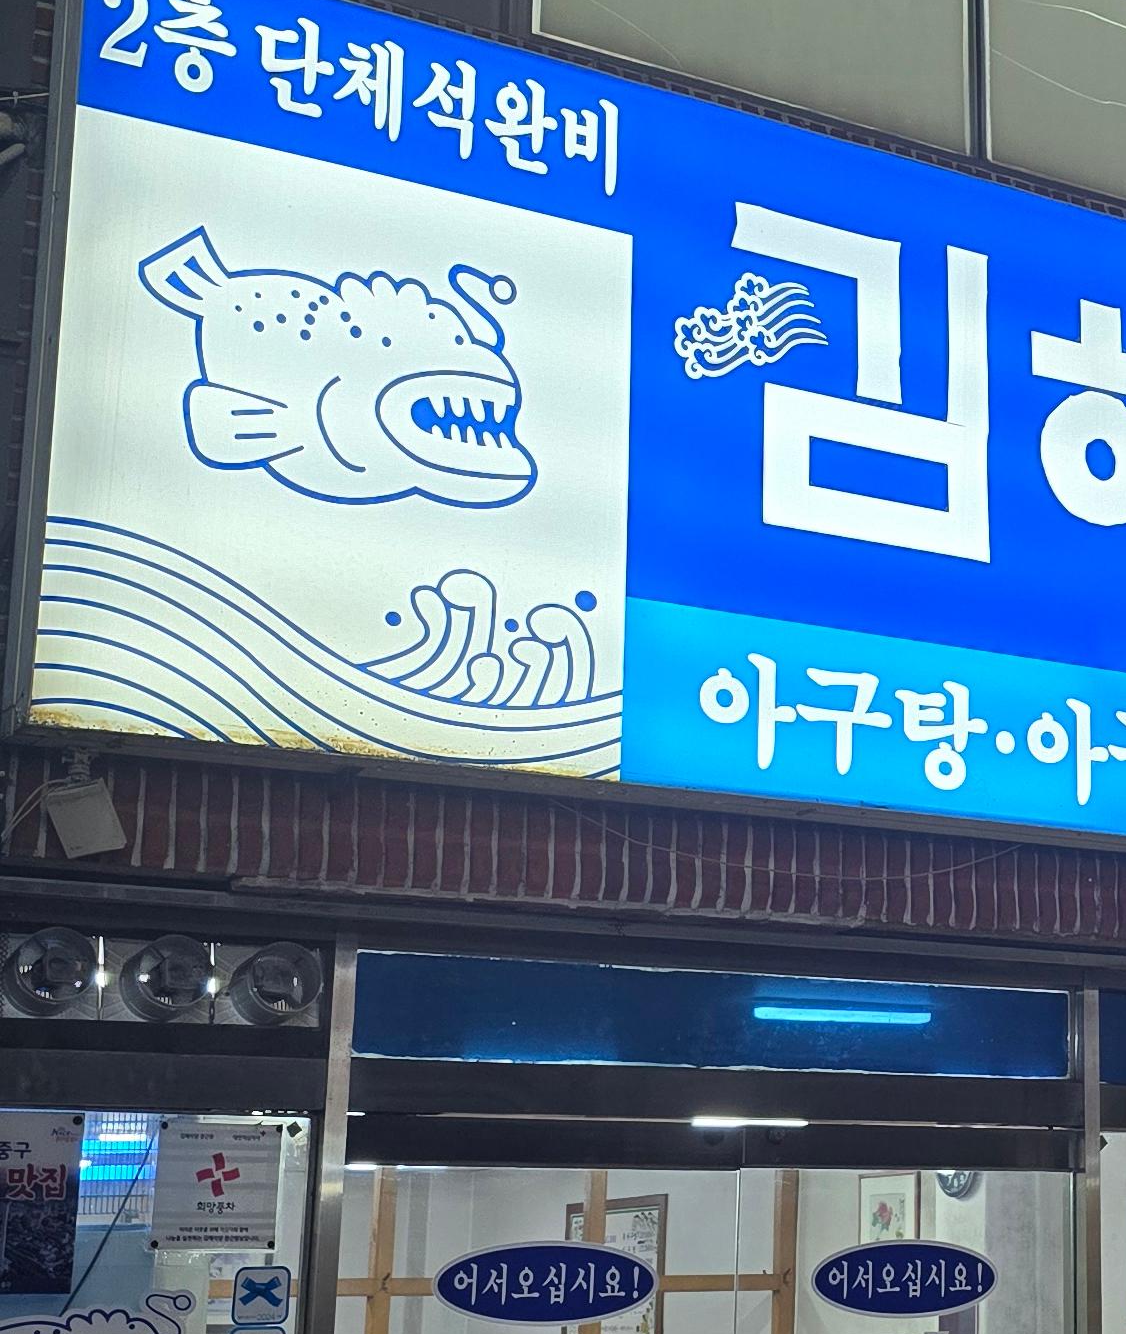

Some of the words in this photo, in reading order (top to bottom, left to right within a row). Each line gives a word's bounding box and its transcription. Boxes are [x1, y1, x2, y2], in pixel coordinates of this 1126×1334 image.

[255, 16, 620, 196] 단체석완비
[7, 1163, 67, 1200] 맛집
[196, 1201, 235, 1215] 희망풍차
[452, 1259, 642, 1308] 어서오십시요!
[826, 1254, 984, 1301] 어서오십시요!
